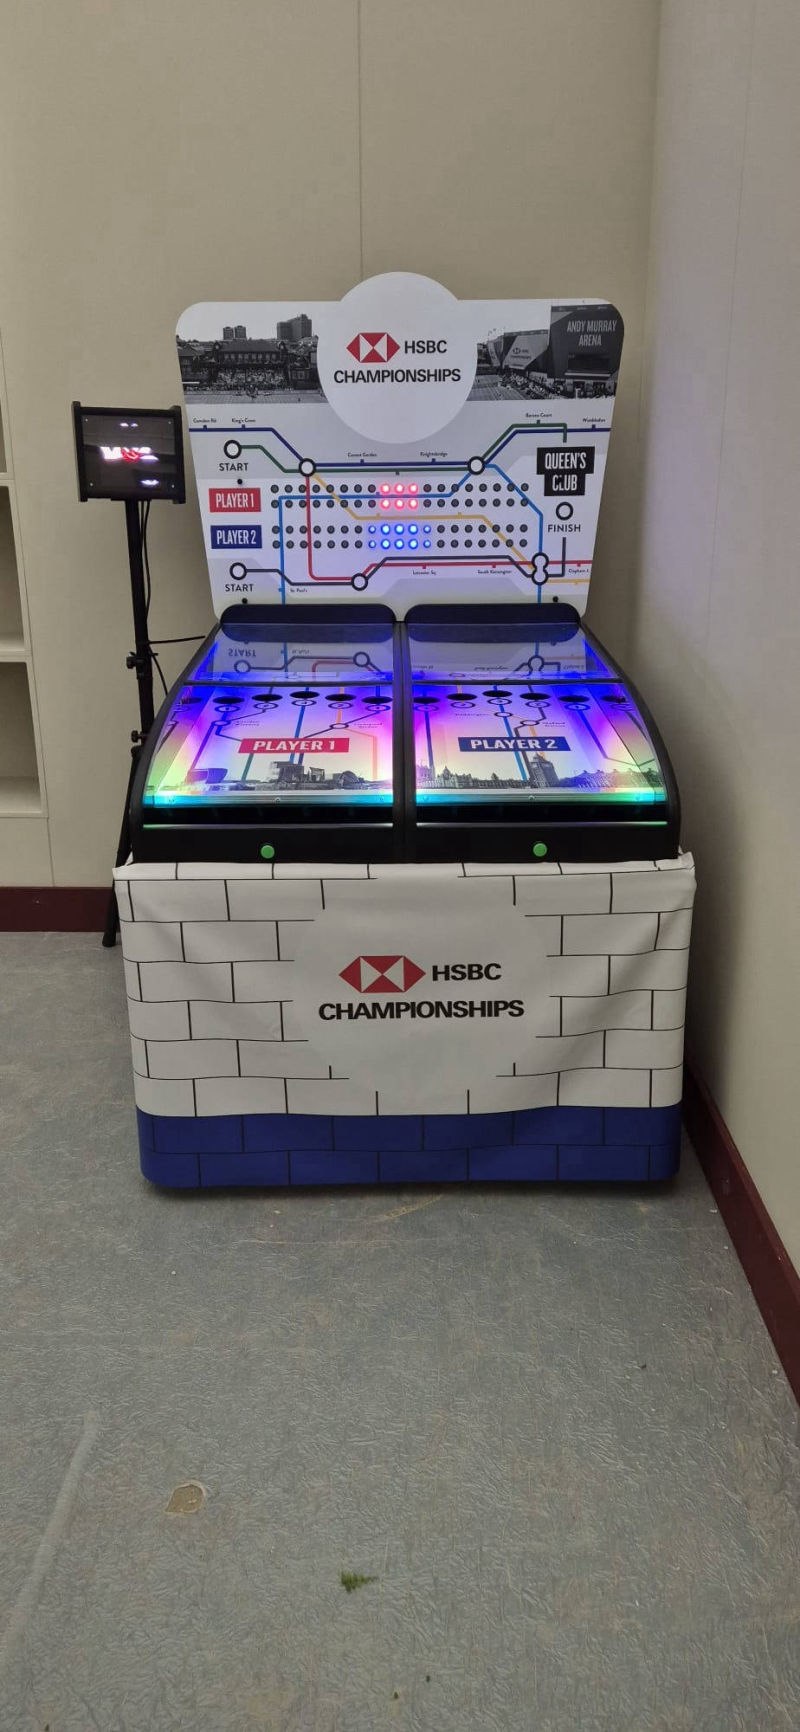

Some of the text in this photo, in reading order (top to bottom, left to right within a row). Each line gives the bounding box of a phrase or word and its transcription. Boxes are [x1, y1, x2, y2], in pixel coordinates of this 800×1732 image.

[567, 319, 617, 332] ANDY MURRAY
[404, 340, 447, 354] HSBC
[579, 334, 602, 346] ARENA
[333, 368, 462, 383] CHAMPIONSHIPS
[219, 463, 248, 472] START
[544, 452, 587, 470] QUEEN'S
[552, 474, 578, 492] CLUB
[215, 493, 254, 508] PLAYER 1
[547, 524, 581, 533] FINISH
[216, 529, 257, 545] PLAYER 2
[225, 583, 253, 592] START
[253, 740, 335, 751] PLAYER 1
[470, 739, 558, 749] PLAYER 2
[432, 963, 502, 981] HSBC
[318, 999, 525, 1021] CHAMPIONSHIPS
